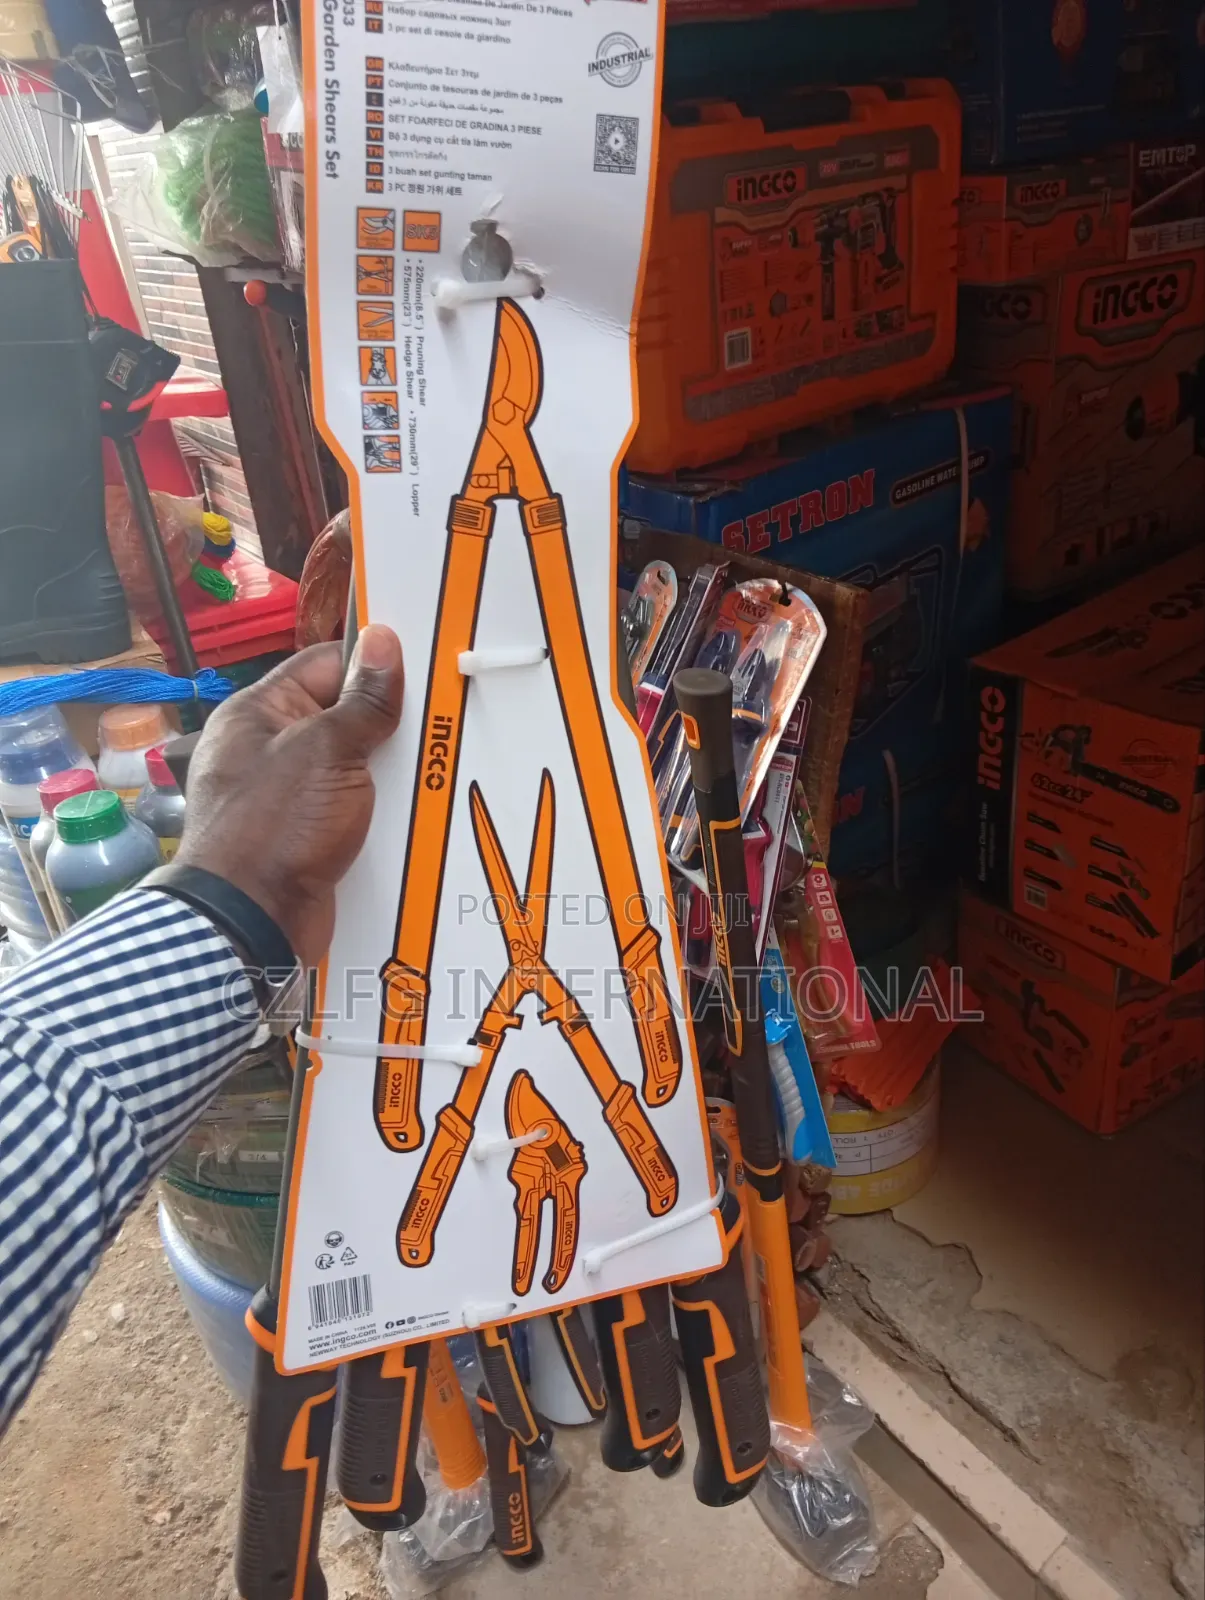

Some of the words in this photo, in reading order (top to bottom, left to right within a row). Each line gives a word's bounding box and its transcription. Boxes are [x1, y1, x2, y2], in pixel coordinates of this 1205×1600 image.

[526, 4, 537, 14] De
[539, 5, 546, 14] 3
[546, 6, 573, 18] Pièces
[323, 0, 341, 72] Garden
[388, 22, 393, 32] 3
[395, 25, 407, 34] pc
[408, 26, 422, 35] set
[424, 27, 433, 36] di
[464, 31, 475, 41] da
[476, 33, 511, 45] giardino
[588, 47, 651, 74] INDUSTRIAL
[388, 79, 429, 92] Conjunto
[430, 83, 441, 93] de
[442, 84, 480, 96] tesouras
[481, 87, 492, 97] de
[493, 87, 519, 100] jardim
[520, 90, 532, 101] de
[533, 92, 539, 101] 3
[324, 78, 342, 145] Shears
[388, 113, 406, 124] SET
[408, 115, 454, 128] FOARFECI
[455, 119, 468, 130] DE
[469, 121, 510, 134] GRADINA
[511, 124, 516, 134] 3
[517, 125, 543, 136] PIESE
[402, 132, 408, 141] 3
[325, 150, 341, 180] Set
[388, 165, 393, 175] 3
[395, 166, 417, 177] buah
[419, 168, 432, 177] set
[433, 169, 466, 181] gunting
[467, 172, 493, 182] taman
[388, 182, 393, 192] 3
[395, 183, 406, 193] PC
[406, 223, 440, 240] SK5
[403, 336, 412, 367] Hedge
[416, 336, 425, 375] Pruning
[406, 370, 415, 400] Shear
[418, 378, 427, 407] Shear
[411, 483, 420, 517] Lopper
[895, 476, 936, 500] GASOLINE
[722, 468, 876, 553] SETRON
[309, 1345, 338, 1358] NEWWAY
[339, 1334, 381, 1349] TECHNOLOGY
[426, 1318, 450, 1328] LIMITED
[309, 1329, 377, 1351] www.ingco.com
